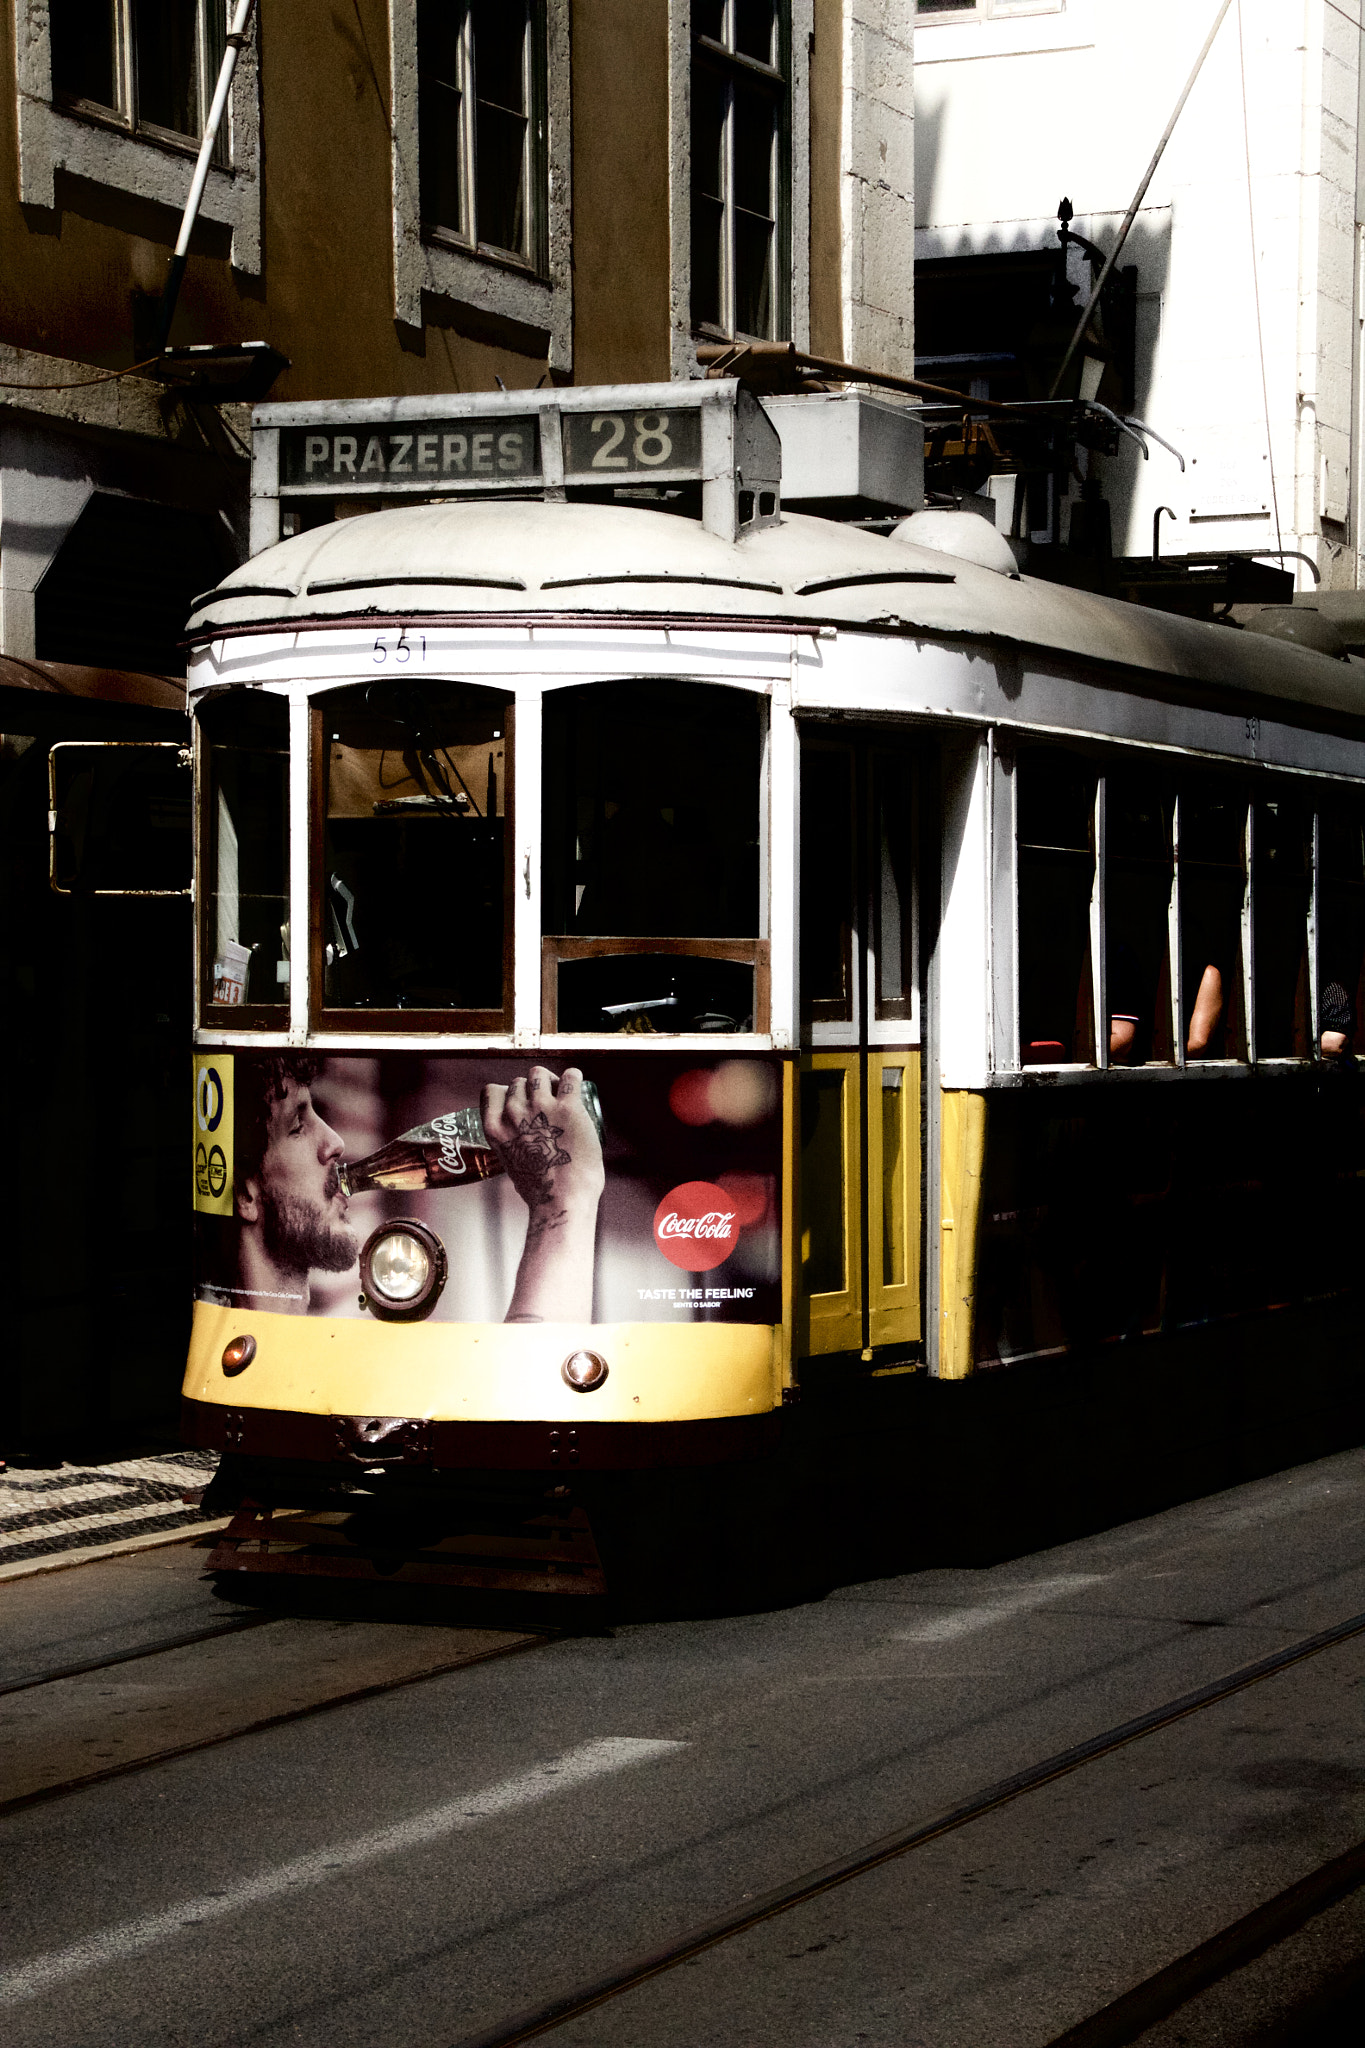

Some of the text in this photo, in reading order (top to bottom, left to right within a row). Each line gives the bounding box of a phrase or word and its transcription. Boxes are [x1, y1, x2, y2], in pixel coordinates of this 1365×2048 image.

[304, 411, 673, 474] PRAZERES 28
[373, 635, 426, 664] 551
[657, 1212, 735, 1239] Coca-Cola
[637, 1288, 676, 1300] TASTE
[678, 1288, 703, 1300] THE
